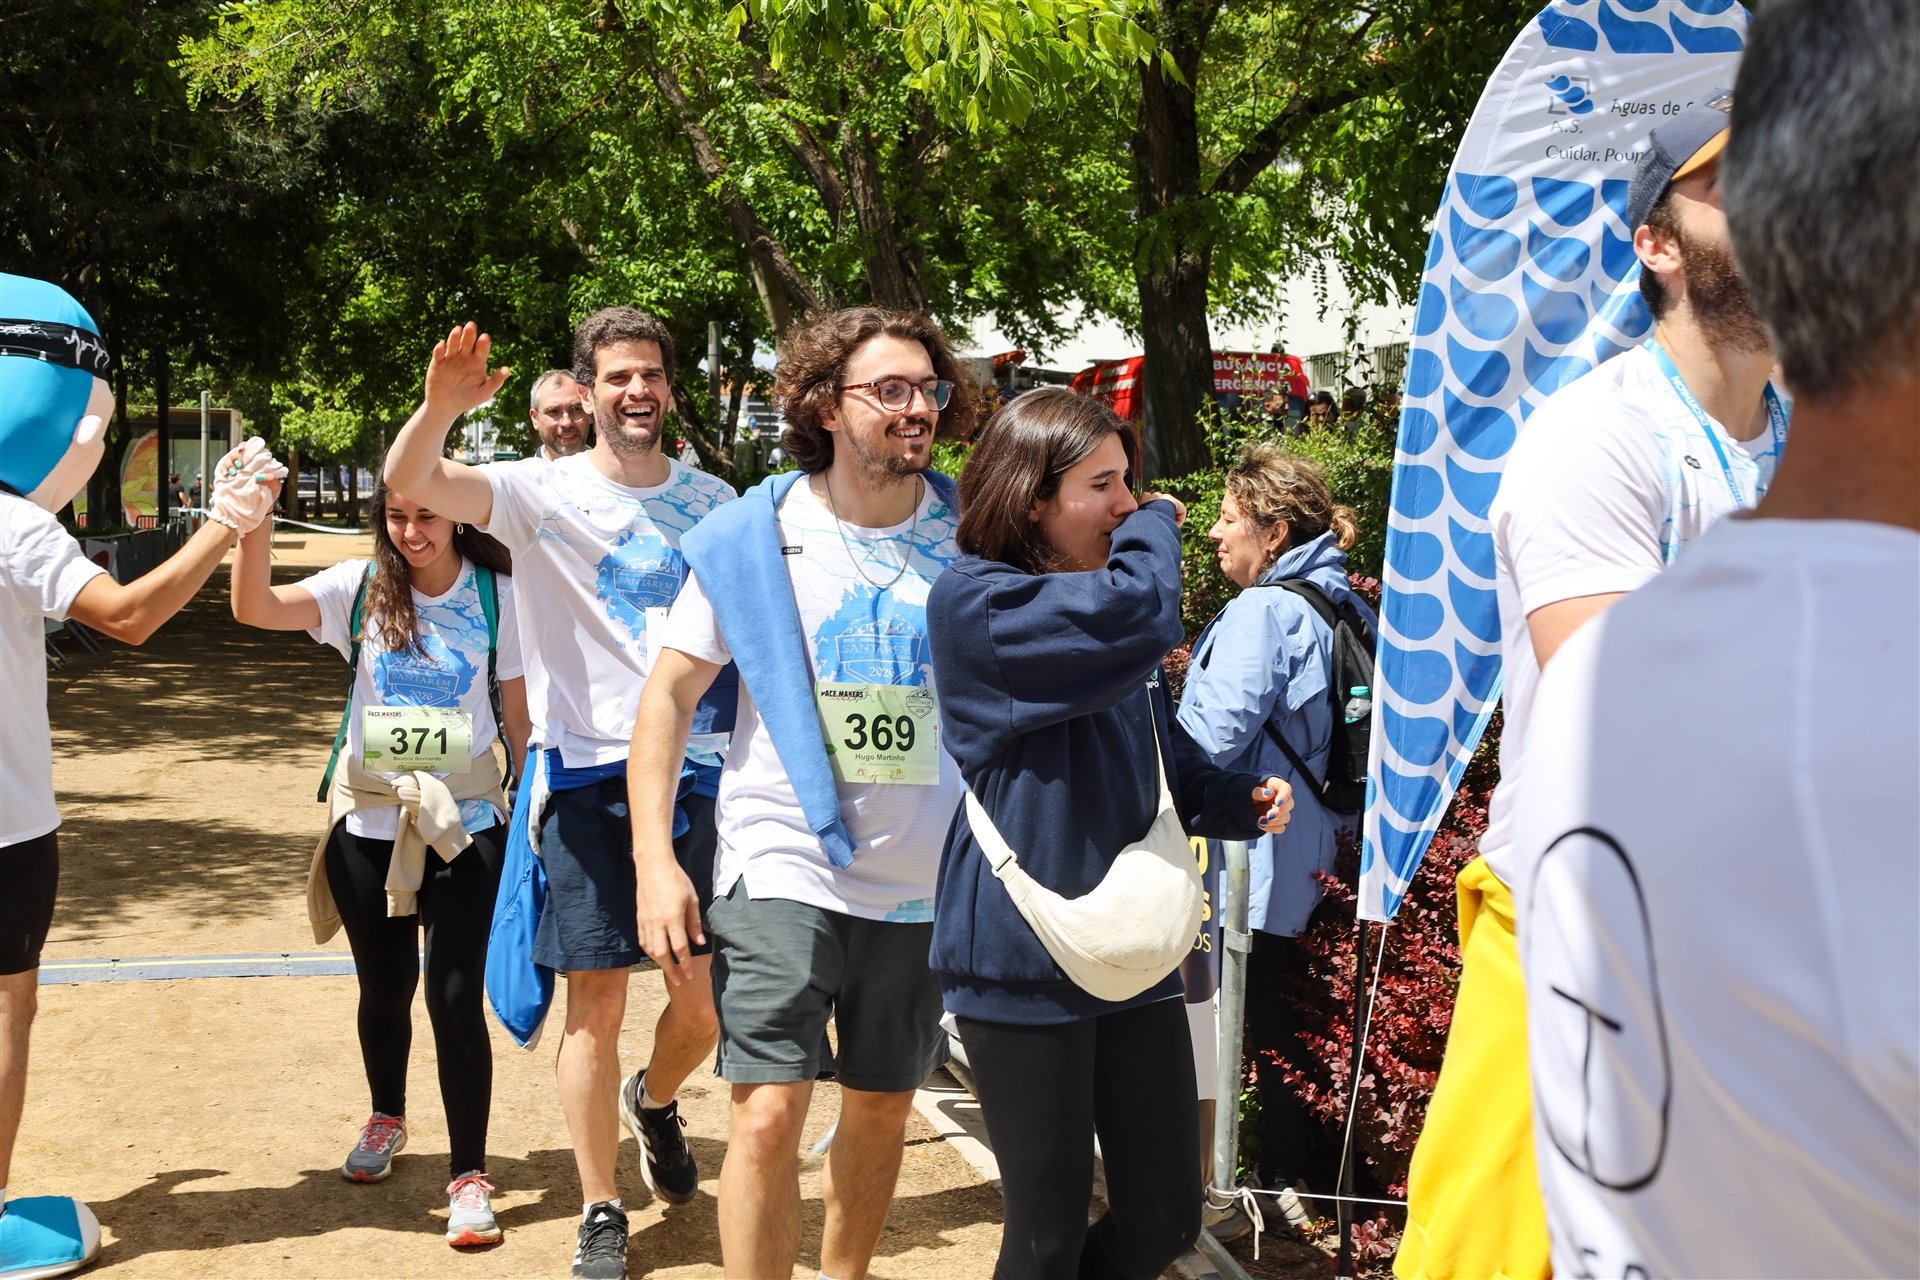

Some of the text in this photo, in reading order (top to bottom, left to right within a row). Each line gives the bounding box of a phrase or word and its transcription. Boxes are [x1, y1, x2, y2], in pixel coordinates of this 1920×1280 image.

[1610, 98, 1656, 117] Águas
[1662, 101, 1681, 116] de
[1551, 119, 1583, 134] A.S.
[1545, 145, 1644, 164] Cuidar. Poup
[1213, 358, 1292, 373] BULÂNCIA
[1214, 378, 1292, 392] ERGÊNCIA
[1670, 375, 1710, 426] DECATHLON
[1767, 397, 1788, 442] DECATHLON
[618, 576, 673, 591] SANTARÉM
[842, 642, 912, 655] SANTARÉM
[391, 671, 451, 687] SANTARÉM
[410, 690, 433, 700] 2026
[844, 713, 915, 752] 369
[389, 727, 447, 755] 371
[855, 753, 906, 762] Hugo Martinho
[1193, 931, 1212, 953] OS
